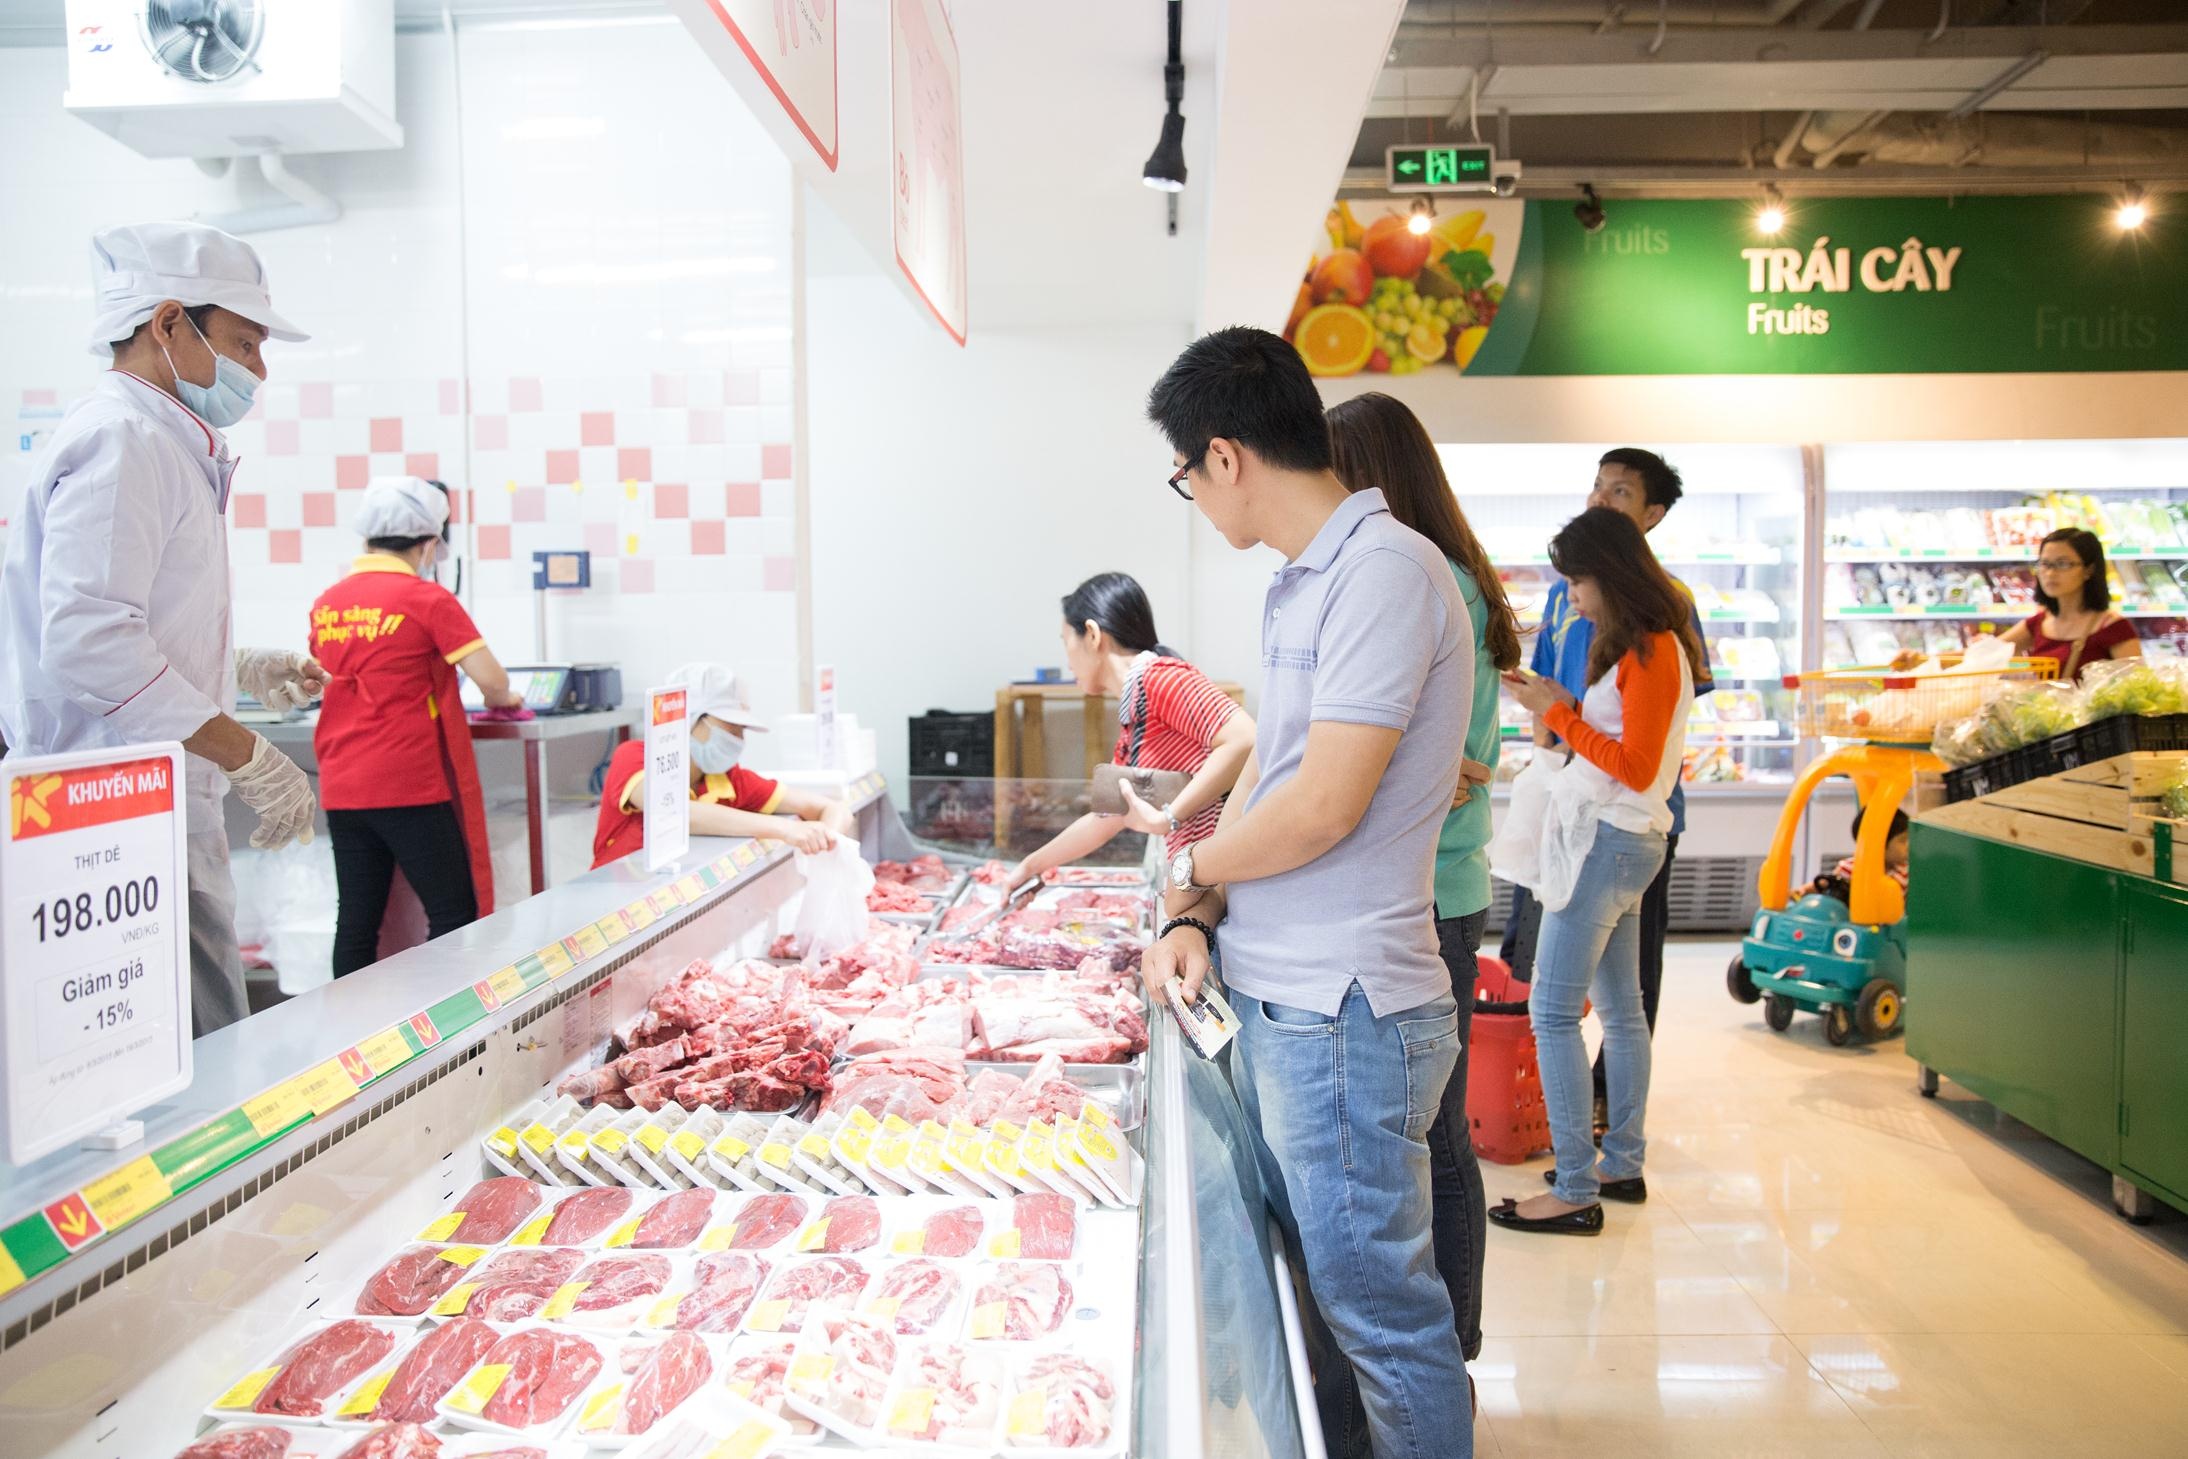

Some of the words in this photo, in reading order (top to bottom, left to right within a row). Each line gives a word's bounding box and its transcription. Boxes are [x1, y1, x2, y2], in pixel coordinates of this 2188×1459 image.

[1741, 236, 1851, 293] TRÁI
[1860, 236, 1962, 293] CÂY
[1747, 302, 1830, 335] Fruits
[2036, 304, 2157, 350] Fruits
[67, 770, 135, 806] KHUYẾN
[137, 766, 168, 794] MÃI
[74, 851, 102, 870] THỊT
[32, 875, 159, 943] 198.000
[62, 972, 112, 1003] Giảm
[118, 956, 144, 990] giá
[96, 998, 134, 1030] 15%
